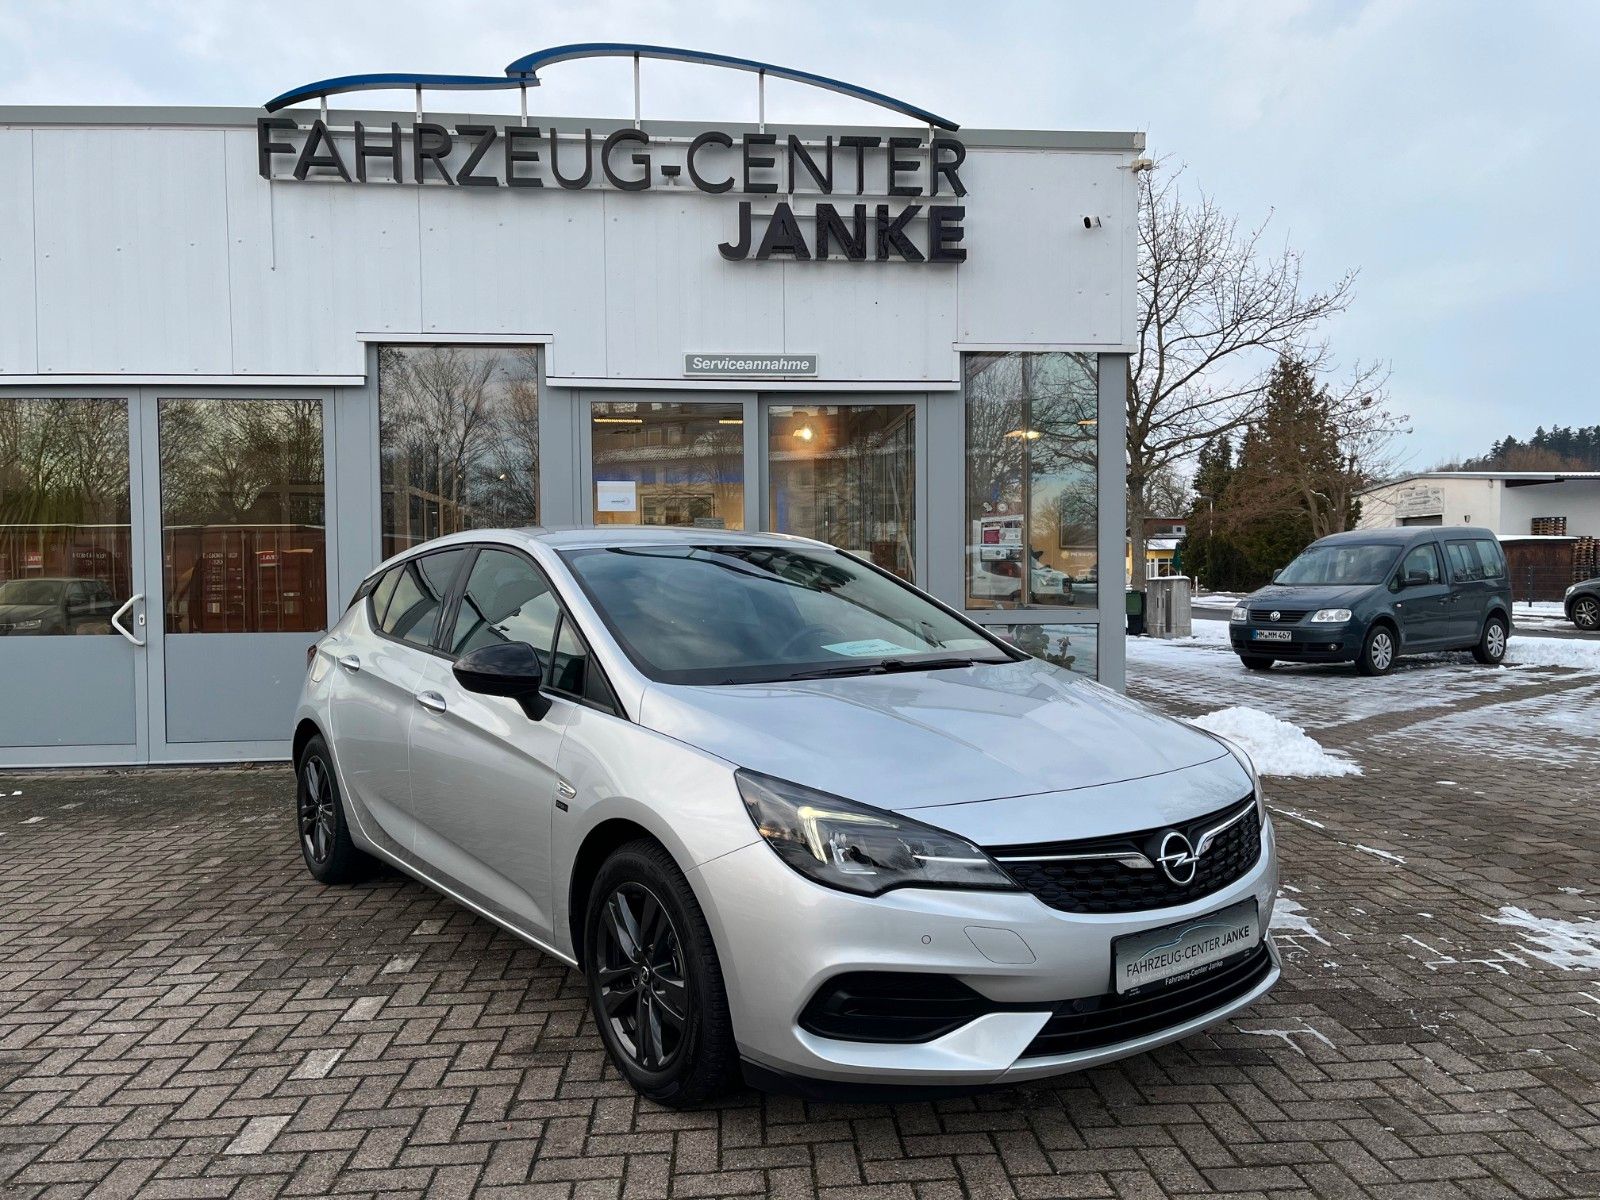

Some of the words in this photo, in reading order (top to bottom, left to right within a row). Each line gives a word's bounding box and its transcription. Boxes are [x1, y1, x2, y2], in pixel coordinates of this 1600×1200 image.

[257, 117, 967, 197] FAHRZEUG-CENTER
[717, 201, 967, 264] JANKE
[692, 356, 810, 371] Serviceannahme
[1126, 936, 1221, 977] FAHRZEUG-CENTER
[1221, 925, 1250, 947] JANKE
[1165, 966, 1208, 986] Fahrzeug-Center
[1208, 960, 1224, 971] Janke
